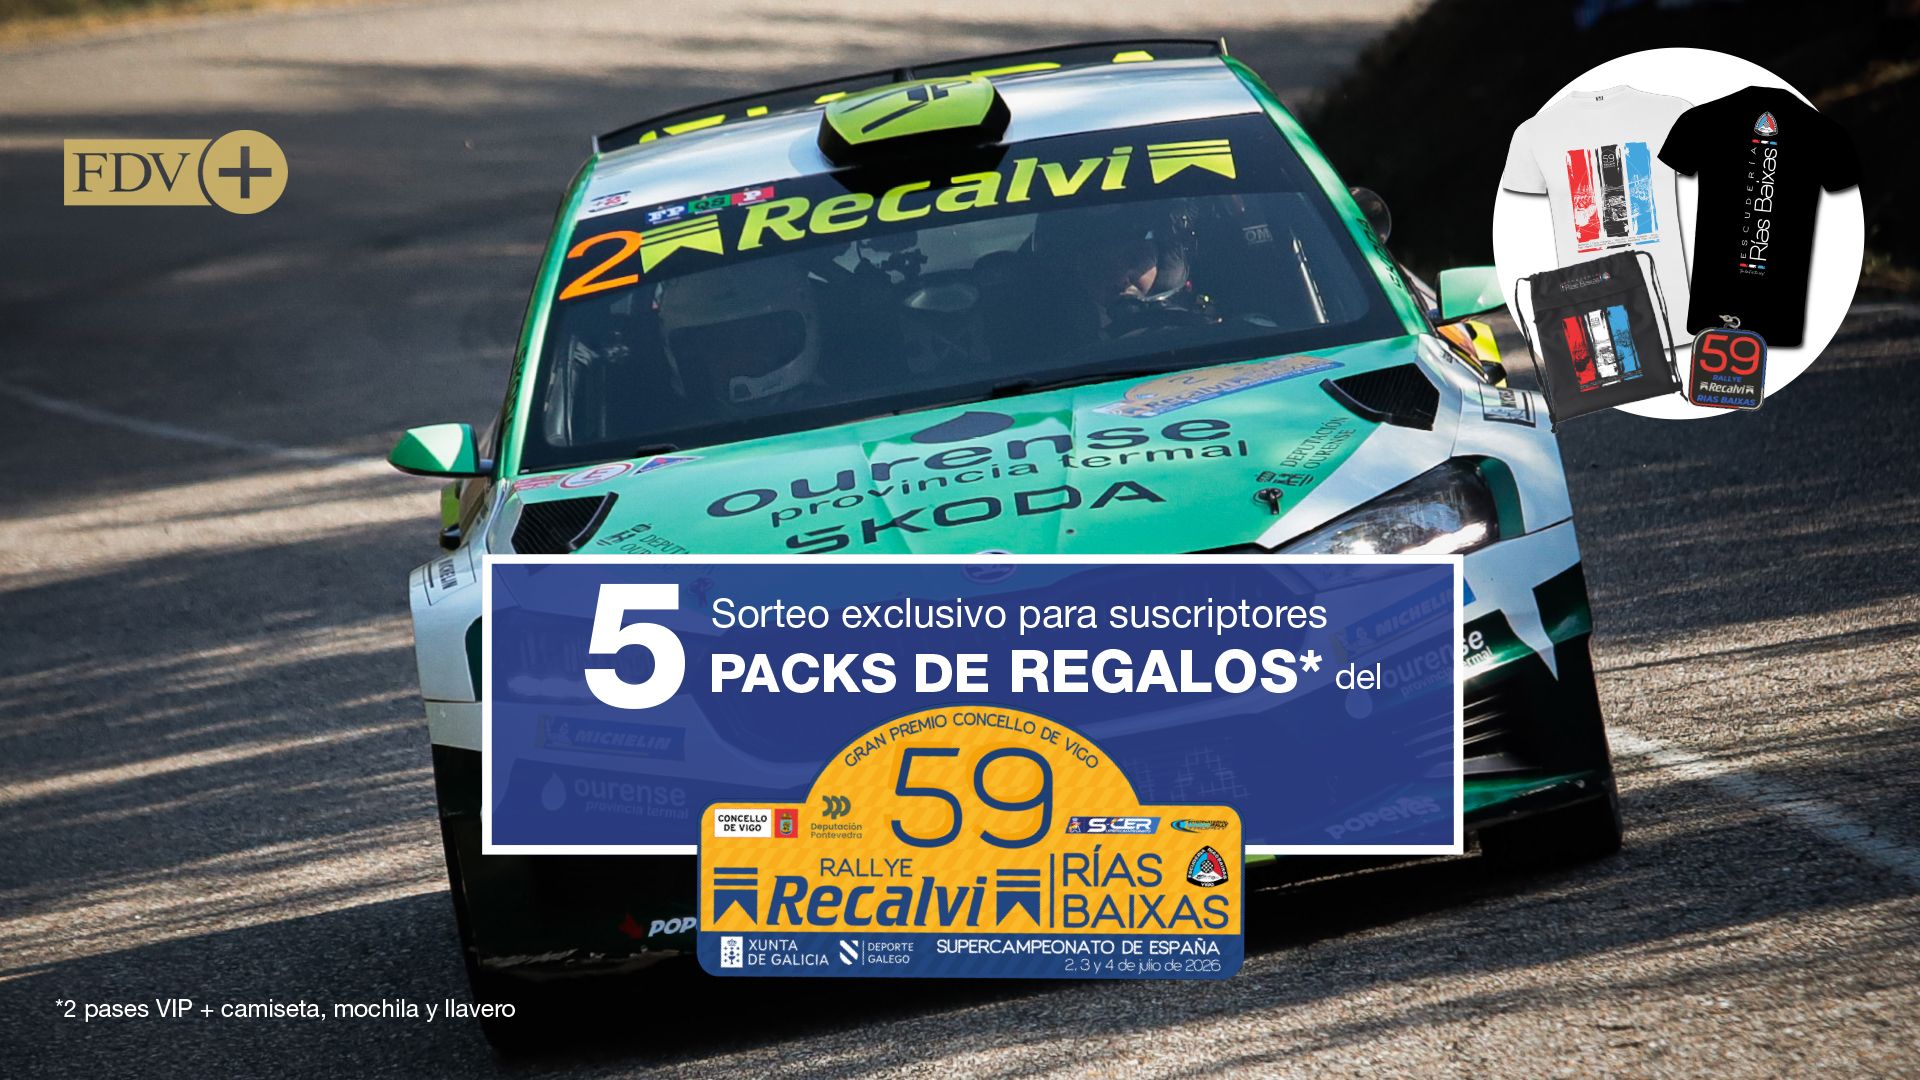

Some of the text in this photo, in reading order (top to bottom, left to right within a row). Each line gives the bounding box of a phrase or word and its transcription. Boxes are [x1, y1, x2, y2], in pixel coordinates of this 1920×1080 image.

[737, 146, 1133, 252] Recalvi
[1754, 148, 1777, 213] Baixas
[1750, 219, 1771, 261] Rías
[559, 230, 642, 301] 2
[1700, 333, 1760, 375] 59
[1709, 382, 1745, 395] Recalvi
[1712, 374, 1742, 383] RALLYE
[1720, 397, 1756, 406] BAIXAS
[1280, 416, 1349, 468] DEPUTACIÓN
[1303, 429, 1356, 470] OURENSE
[707, 419, 1231, 518] ourense
[771, 440, 1248, 528] provincia termal
[574, 729, 672, 750] MICHELIN
[574, 778, 686, 807] ourense
[585, 799, 689, 820] provincia termal
